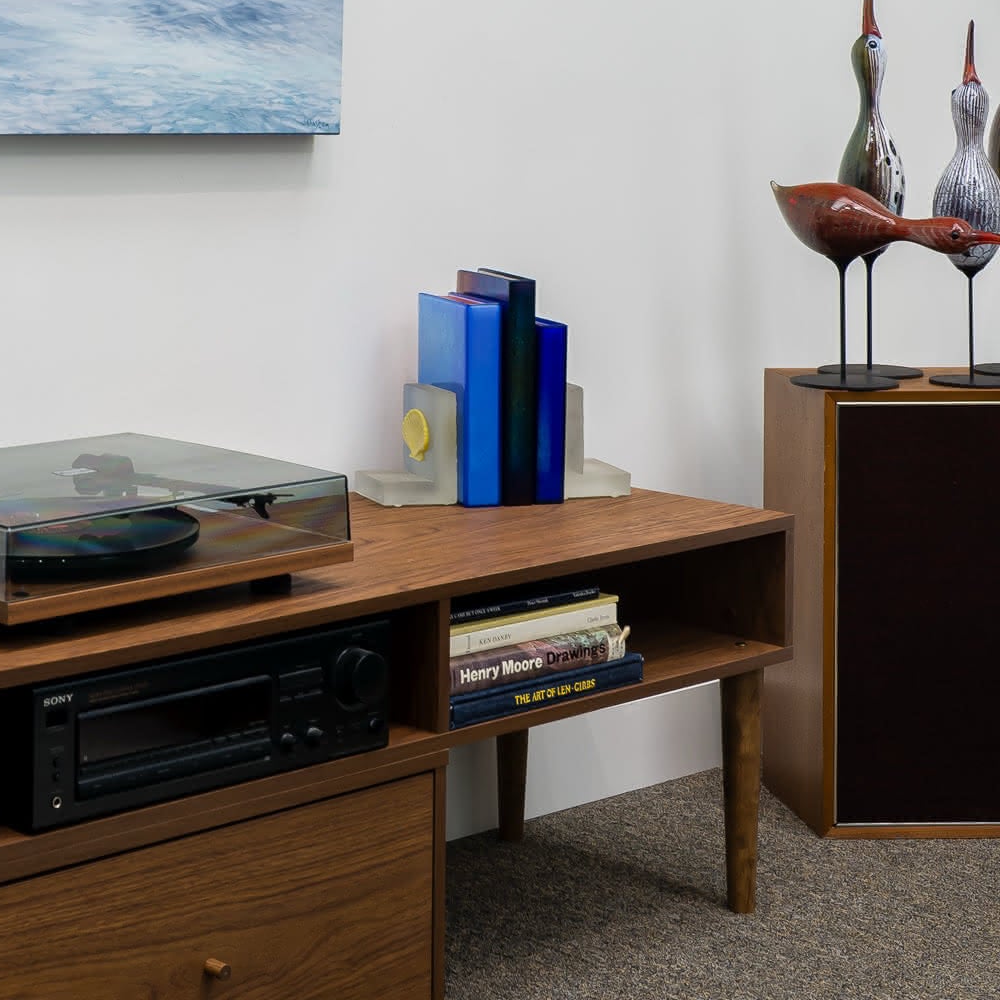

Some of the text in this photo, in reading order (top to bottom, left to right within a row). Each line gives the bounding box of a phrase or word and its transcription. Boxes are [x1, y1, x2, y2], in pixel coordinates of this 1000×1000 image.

[460, 664, 499, 684] Henry
[502, 656, 543, 676] Moore
[546, 642, 606, 665] Drawings
[43, 693, 73, 707] SONY
[514, 693, 531, 705] THE
[532, 689, 546, 702] ART
[546, 687, 556, 698] OF
